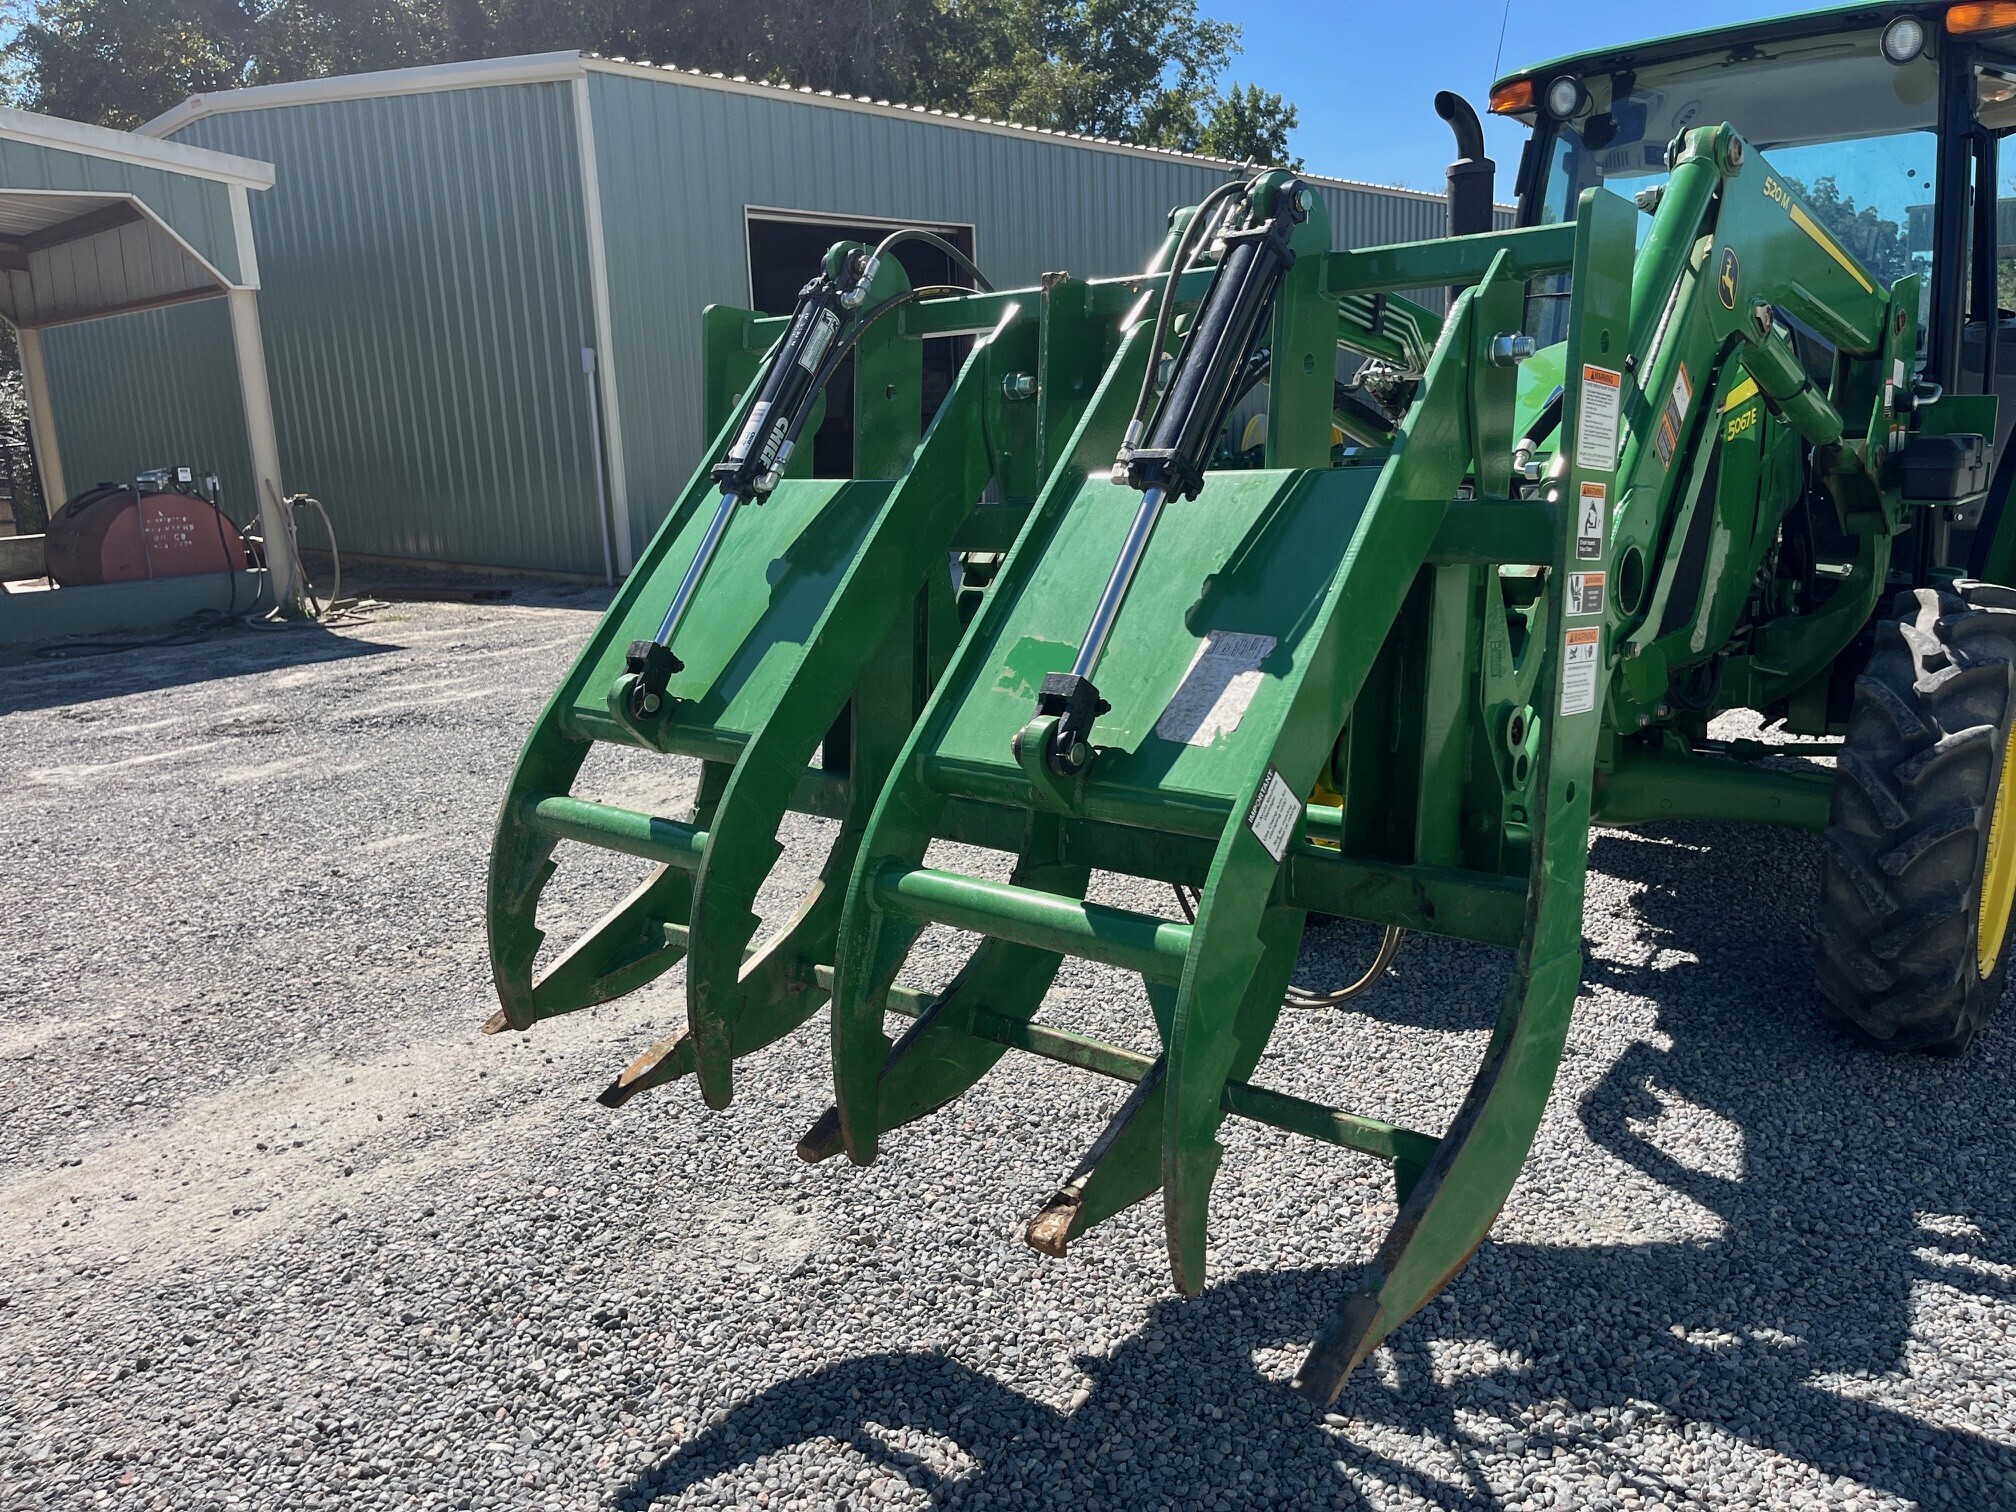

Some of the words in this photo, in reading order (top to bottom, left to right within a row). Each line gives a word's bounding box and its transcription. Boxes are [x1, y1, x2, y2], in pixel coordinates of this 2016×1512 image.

[1594, 371, 1614, 384] WARNING
[1728, 407, 1757, 441] 5067E
[759, 417, 789, 471] CHIEF
[1574, 630, 1597, 642] WARNING
[1247, 768, 1274, 824] IMPORTANT
